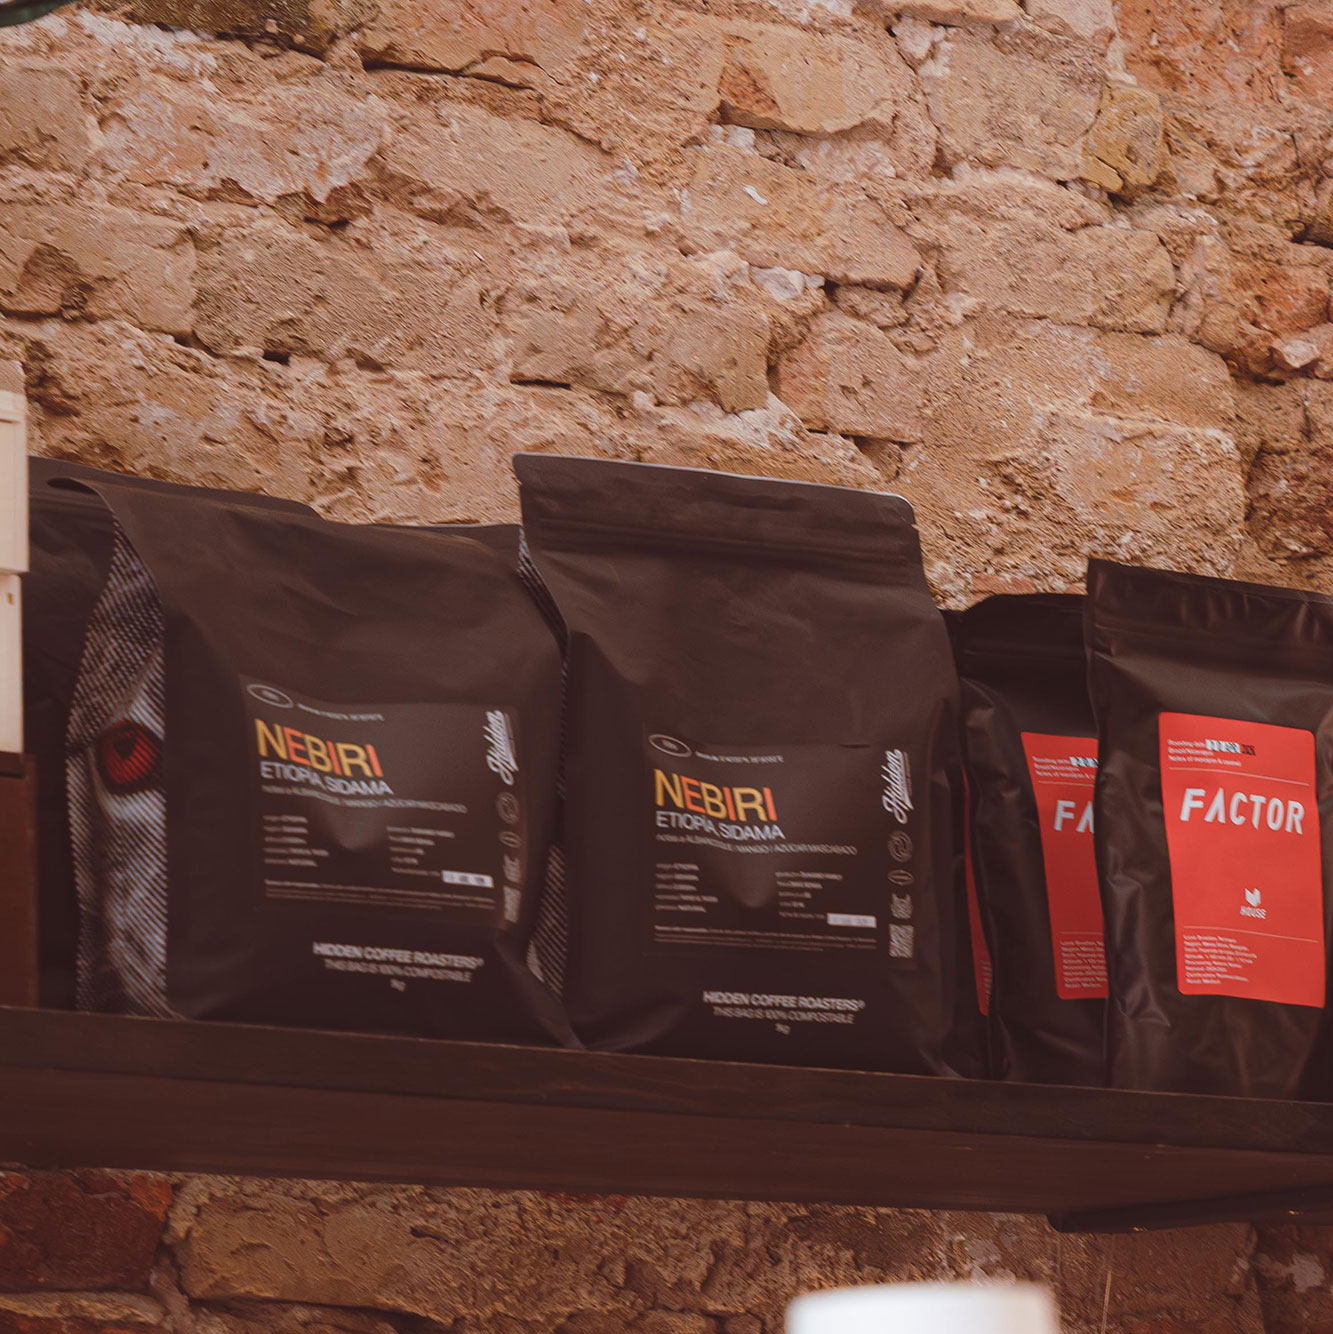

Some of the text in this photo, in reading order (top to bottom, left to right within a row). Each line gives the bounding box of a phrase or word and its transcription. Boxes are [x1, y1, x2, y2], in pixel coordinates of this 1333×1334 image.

[253, 718, 384, 778] NEBIRI
[325, 775, 394, 796] SIDAMA
[653, 767, 779, 822] NEBIRI
[1180, 787, 1304, 836] FACTOR
[718, 822, 786, 841] SIDAMA
[1240, 905, 1267, 920] HOUSE
[312, 941, 363, 959] HIDDEN
[363, 945, 412, 963] COFFEE
[703, 990, 750, 1005] HIDDEN
[750, 993, 797, 1009] COFFEE
